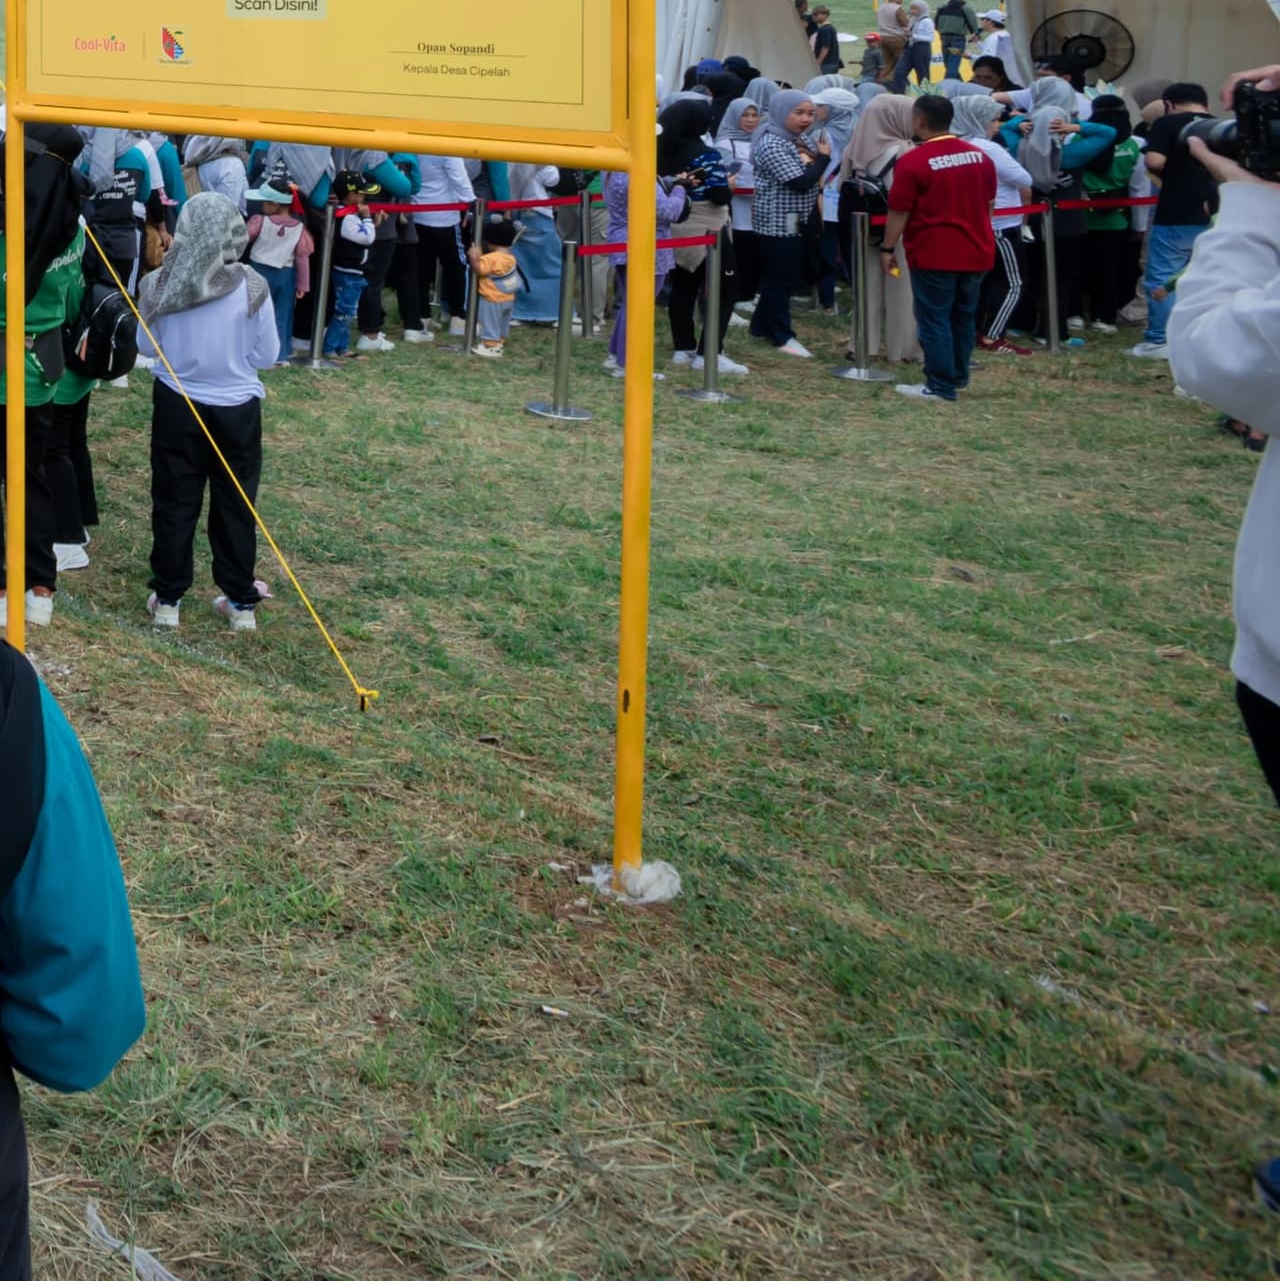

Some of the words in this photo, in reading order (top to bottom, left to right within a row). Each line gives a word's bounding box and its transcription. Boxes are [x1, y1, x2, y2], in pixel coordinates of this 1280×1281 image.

[73, 35, 127, 53] Cool-Vita
[417, 41, 446, 54] Opan
[449, 43, 496, 56] Sopandi
[402, 62, 439, 76] Kepala
[440, 64, 467, 76] Desa
[469, 65, 511, 78] Cipelah
[927, 150, 984, 171] SECURITY
